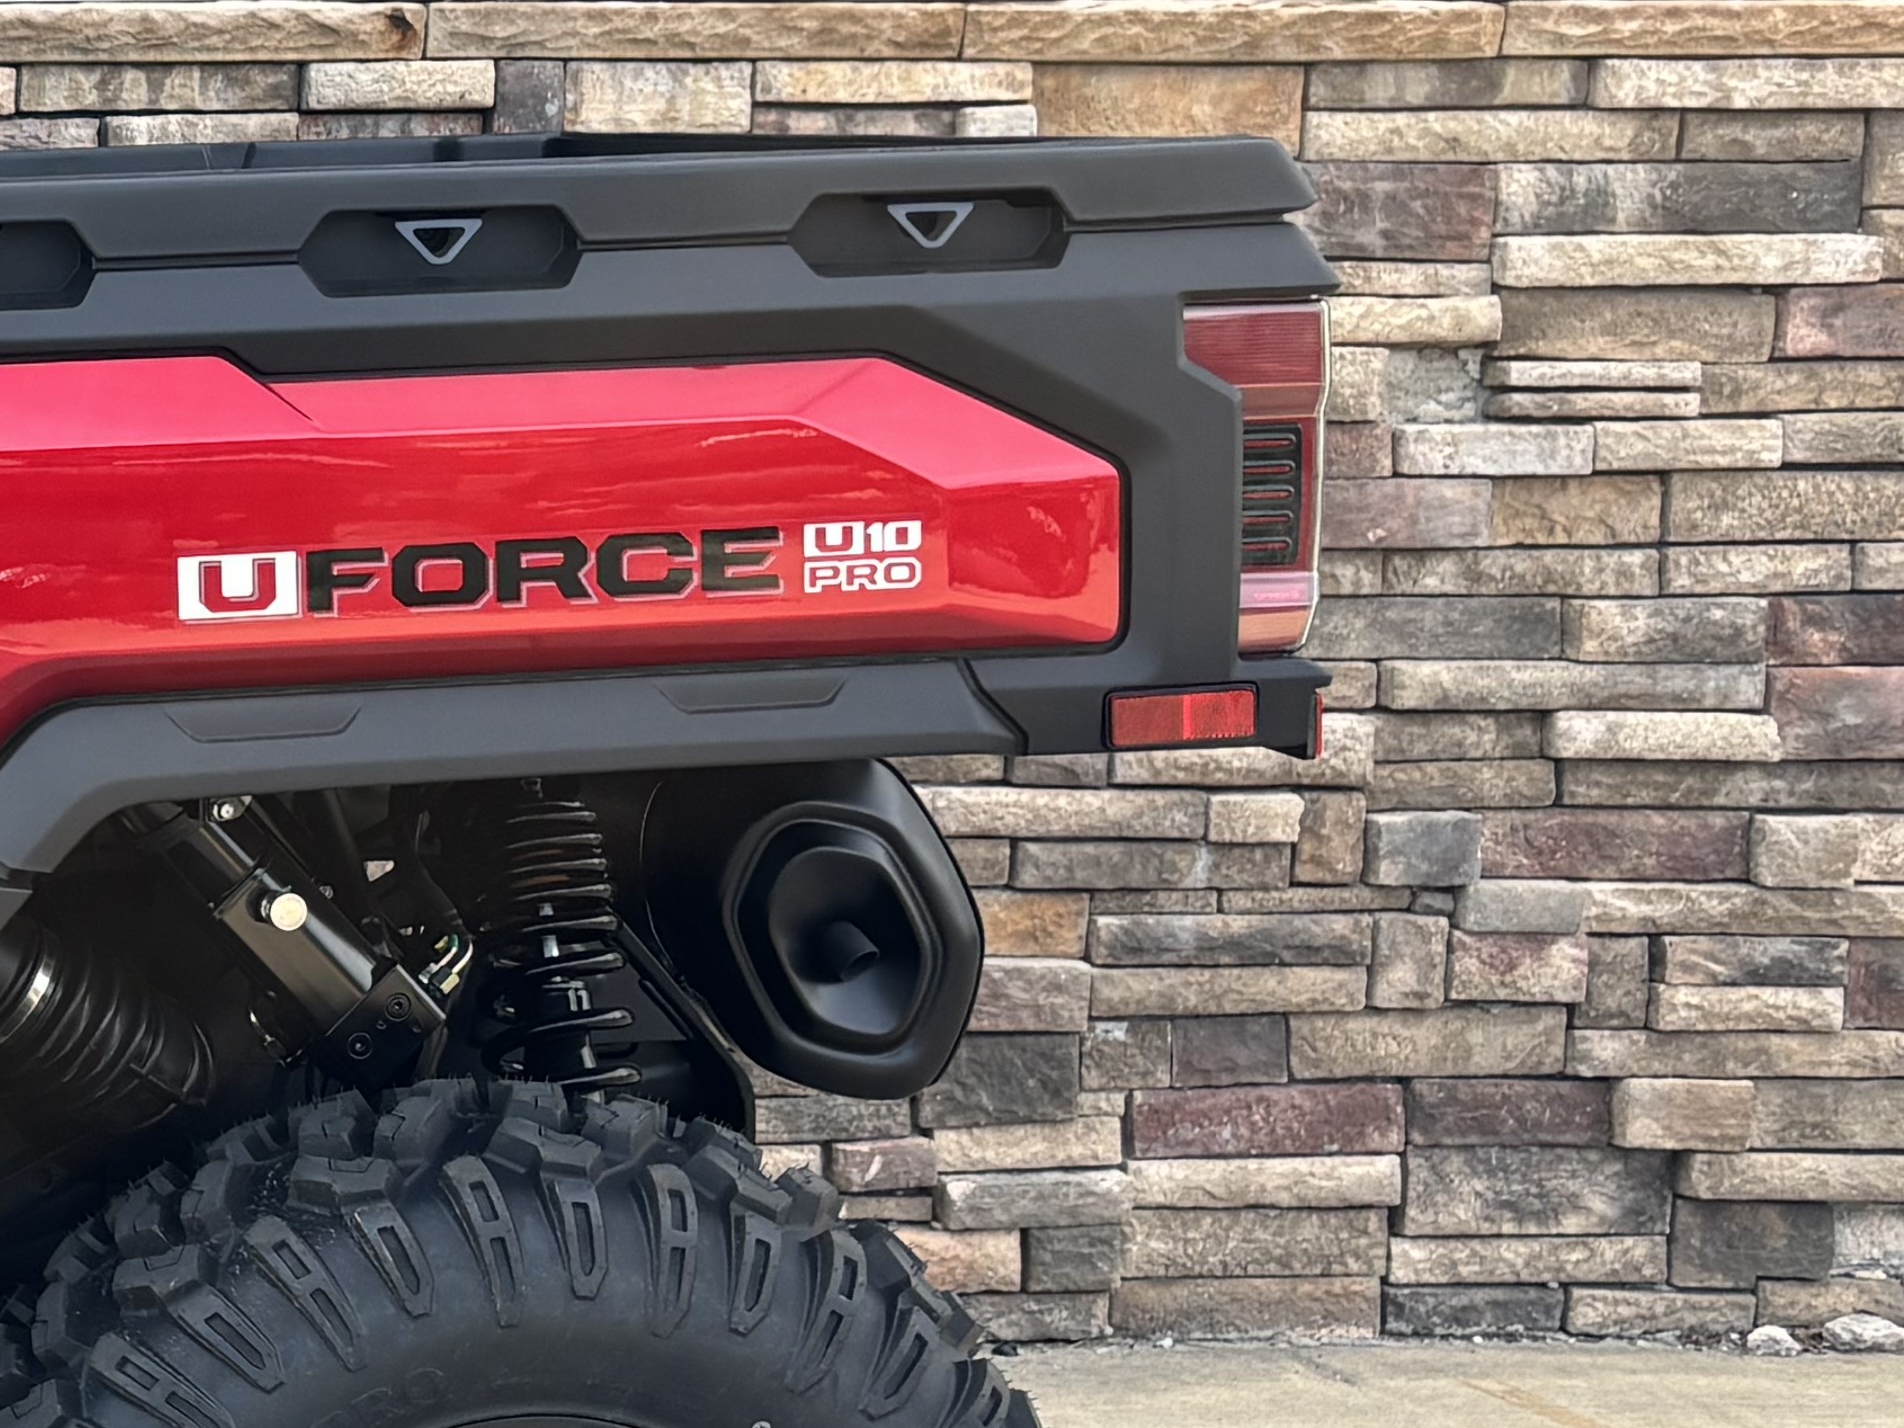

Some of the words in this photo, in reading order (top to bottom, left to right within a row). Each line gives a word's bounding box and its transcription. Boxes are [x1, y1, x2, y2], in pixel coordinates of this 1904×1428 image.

[306, 525, 782, 616] FORCE
[804, 520, 922, 557] U10
[804, 556, 921, 593] PRO
